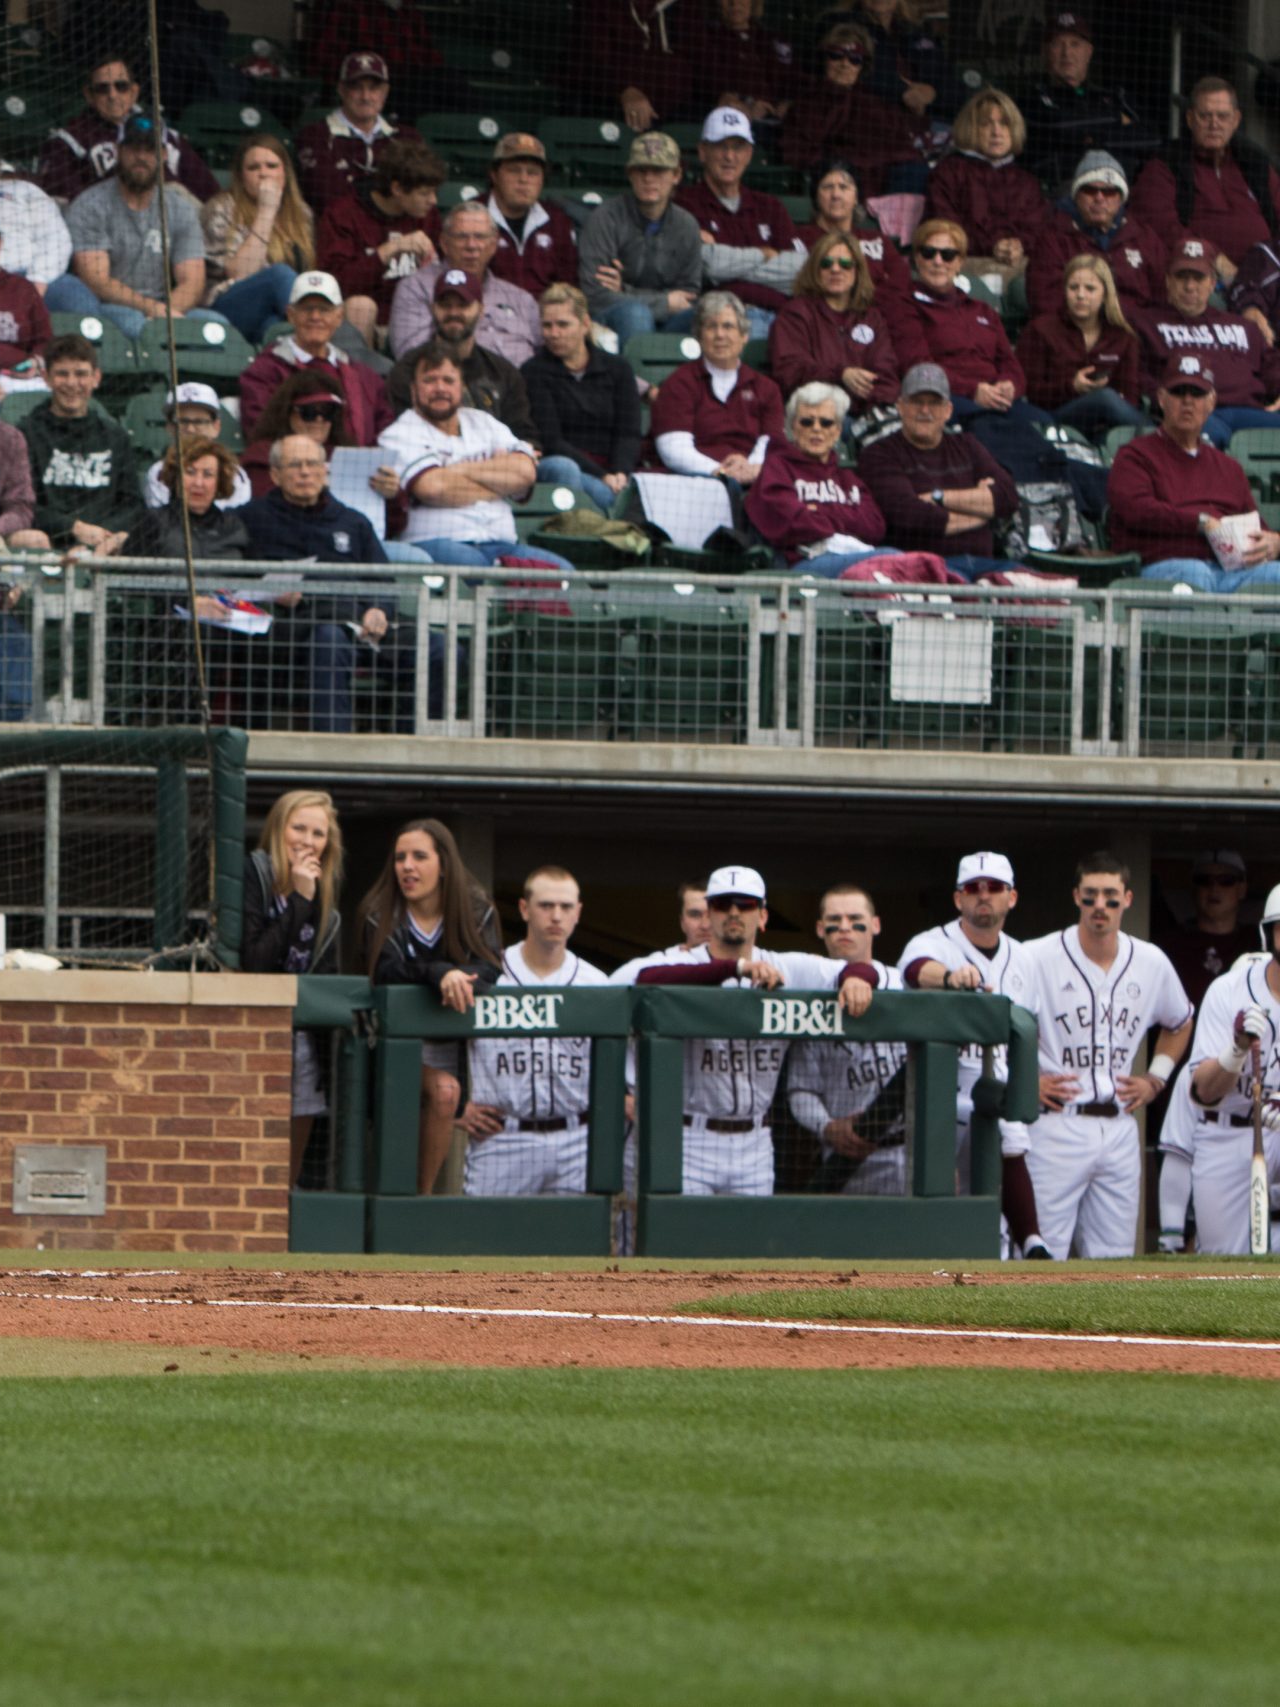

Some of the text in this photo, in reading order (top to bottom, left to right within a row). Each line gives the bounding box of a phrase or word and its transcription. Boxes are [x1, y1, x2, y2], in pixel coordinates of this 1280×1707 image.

[728, 871, 740, 887] T
[473, 993, 564, 1031] BB&T
[1055, 1002, 1141, 1037] TEXAS
